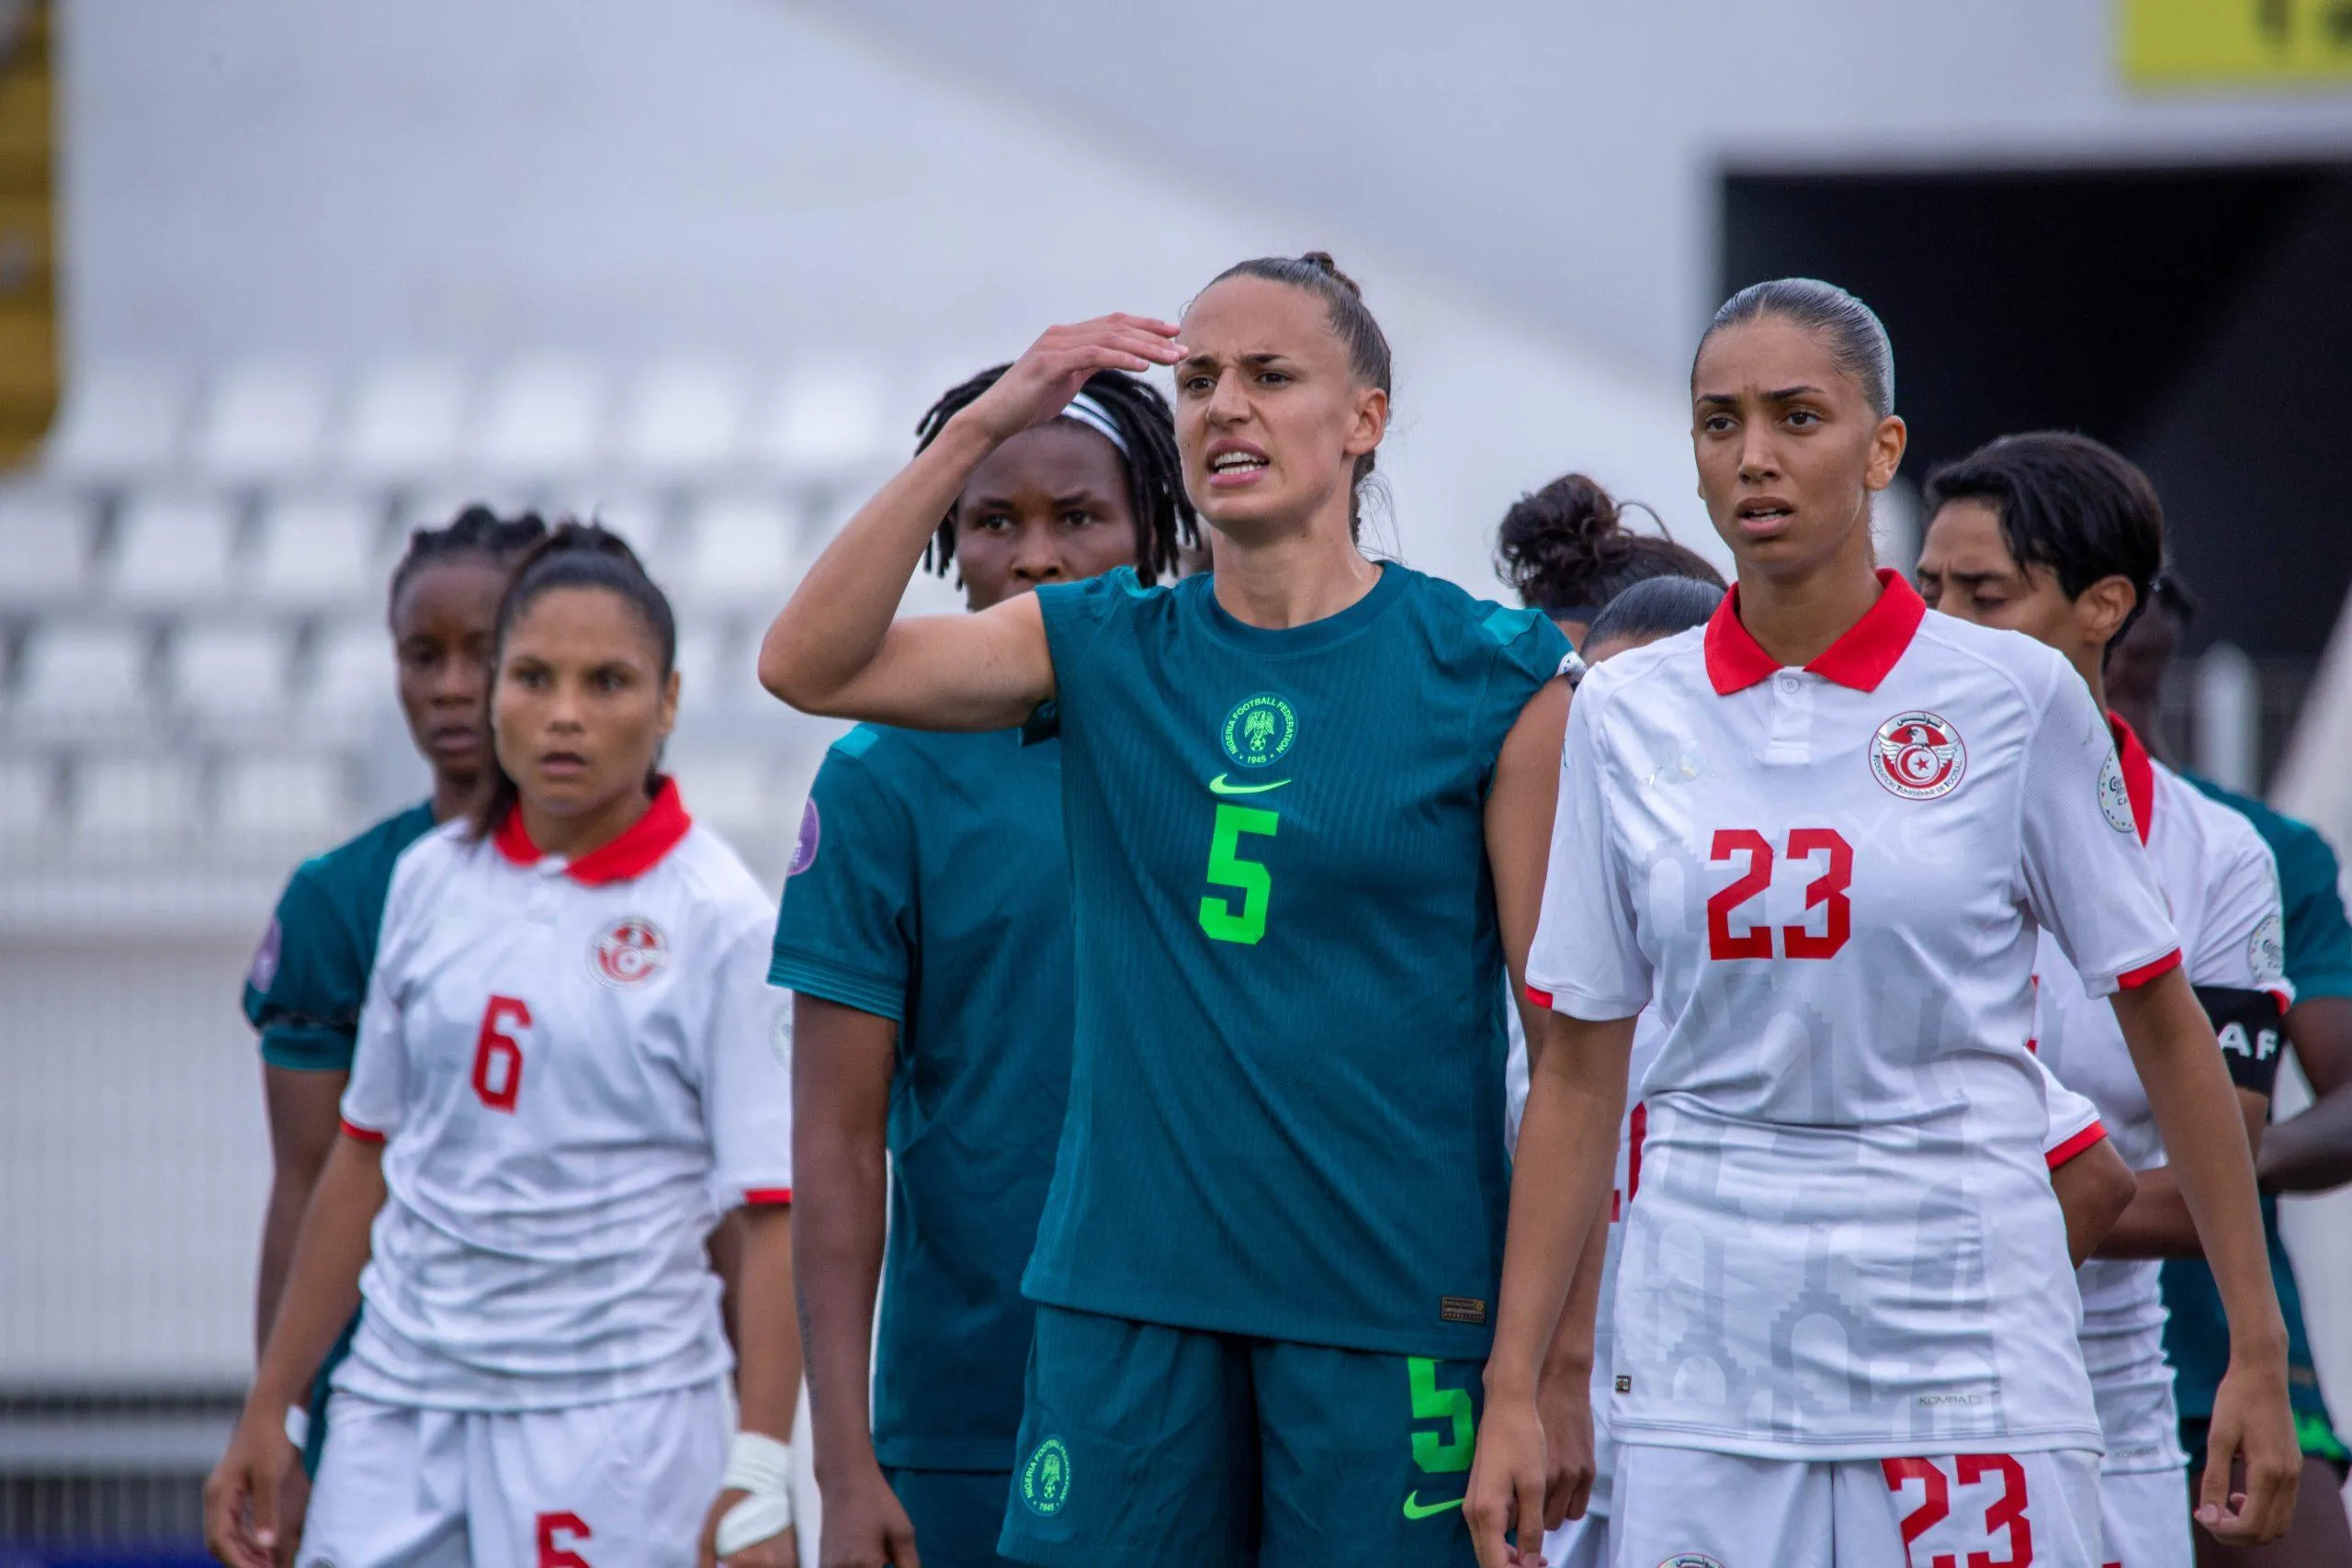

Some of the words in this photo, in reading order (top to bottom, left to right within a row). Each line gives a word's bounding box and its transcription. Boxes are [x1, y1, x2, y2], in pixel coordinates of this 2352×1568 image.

[1225, 720, 1238, 754] NIGERIA
[1232, 697, 1275, 719] FOOTBALL
[1275, 701, 1295, 753] FEDERATION
[1247, 755, 1267, 764] 1945
[1199, 804, 1279, 945] 5
[1707, 829, 1854, 961] 23
[471, 994, 533, 1115] 6
[2217, 1021, 2278, 1061] AF
[1408, 1357, 1476, 1473] 5
[1881, 1453, 2034, 1568] 23
